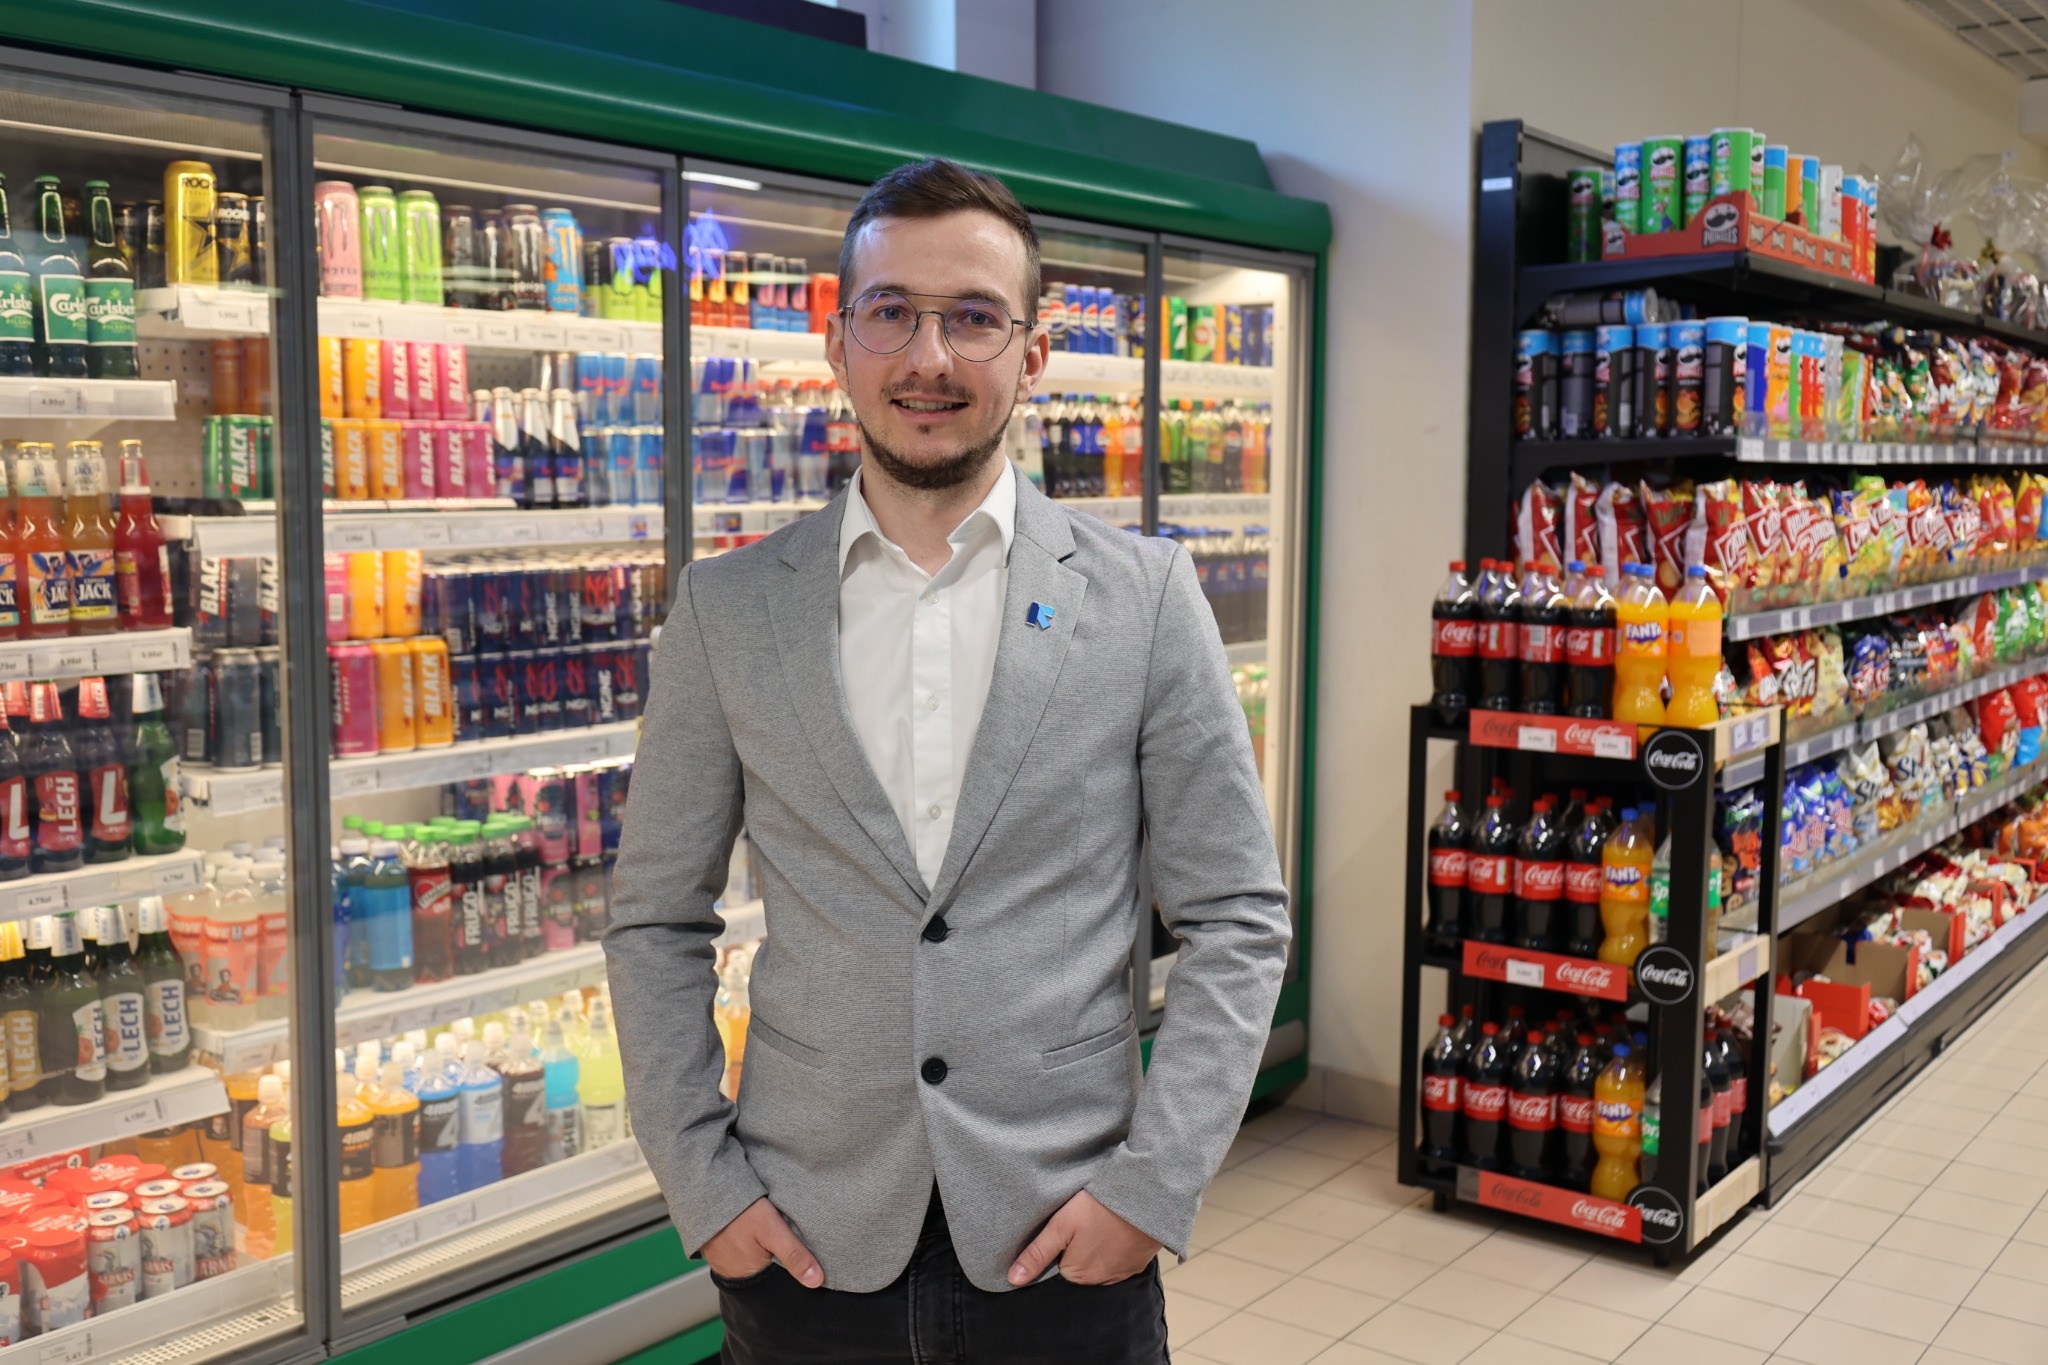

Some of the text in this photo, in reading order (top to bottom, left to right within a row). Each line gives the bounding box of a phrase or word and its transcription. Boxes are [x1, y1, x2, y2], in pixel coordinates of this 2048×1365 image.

[1703, 227, 1740, 247] PRINGLES
[365, 339, 381, 398] BLACK
[393, 342, 409, 400] BLACK
[417, 344, 434, 401] BLACK
[447, 345, 464, 402] BLACK
[230, 425, 250, 487] BLACK
[321, 428, 336, 486] BLACK
[347, 429, 364, 486] BLACK
[382, 429, 399, 486] BLACK
[418, 430, 434, 487] BLACK
[448, 429, 464, 487] BLACK
[78, 583, 112, 601] JACK
[1625, 622, 1663, 639] FANTA
[422, 653, 443, 716] BLACK
[1649, 749, 1699, 771] Coca-Cola
[56, 776, 78, 833] LECH
[100, 771, 127, 825] L
[1605, 866, 1641, 882] FANTA
[1556, 961, 1614, 989] Coca-Cola
[1641, 964, 1690, 987] Coca-Cola
[119, 999, 141, 1053] LECH
[161, 985, 183, 1037] LECH
[12, 1016, 36, 1072] LECH
[1571, 1199, 1629, 1229] Coca-Cola
